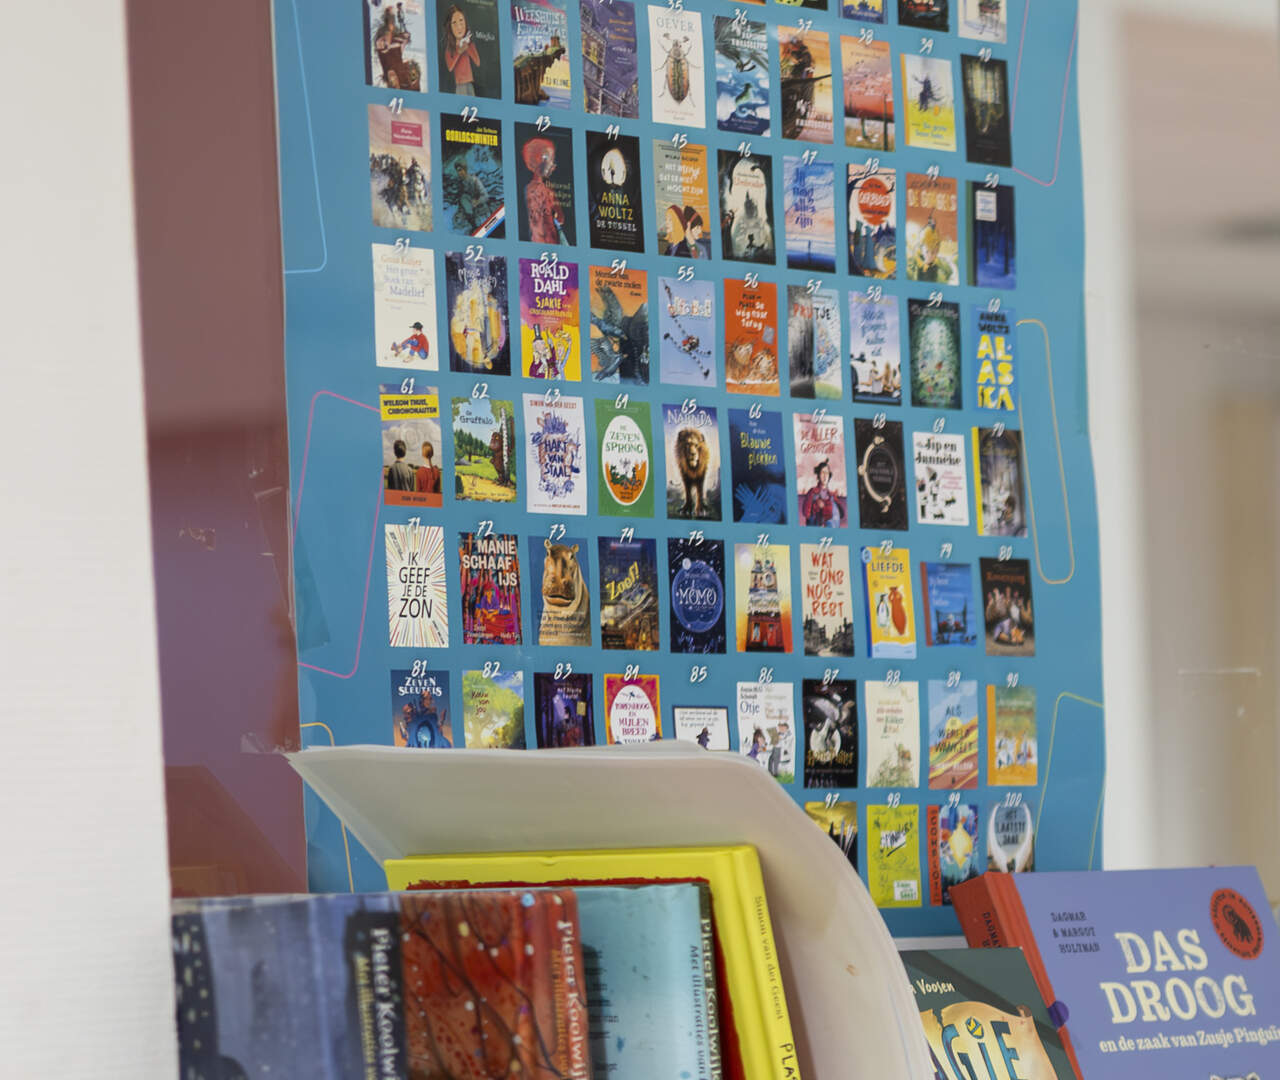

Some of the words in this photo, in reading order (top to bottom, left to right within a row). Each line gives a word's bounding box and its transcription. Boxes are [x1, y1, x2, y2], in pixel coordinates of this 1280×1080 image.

[600, 191, 631, 206] ANNA
[598, 205, 634, 221] WOLTZ
[393, 238, 410, 252] 51
[466, 245, 485, 262] 52
[540, 252, 559, 269] 53
[530, 261, 570, 281] ROALD
[677, 266, 695, 282] 55
[534, 279, 567, 296] DAHL
[743, 273, 759, 289] 56
[400, 377, 415, 394] 61
[471, 383, 490, 399] 62
[544, 388, 561, 404] 63
[681, 398, 697, 415] 65
[459, 415, 494, 426] Gruffalo
[605, 441, 645, 455] SPRONG
[408, 517, 421, 533] 71
[477, 520, 494, 537] 72
[549, 523, 566, 540] 73
[477, 539, 517, 555] MANIE
[408, 551, 419, 567] IK
[462, 554, 513, 571] SCHAAF
[811, 551, 834, 568] WAT
[870, 561, 905, 574] LIEFDE
[398, 567, 431, 585] GEEF
[498, 571, 518, 587] IJS
[402, 585, 414, 598] JE
[415, 585, 428, 598] DE
[398, 598, 433, 620] ZON
[411, 660, 428, 677] 81
[482, 661, 500, 678] 82
[553, 663, 572, 680] 83
[690, 666, 708, 683] 85
[404, 676, 437, 688] ZEVEN
[398, 686, 443, 697] SLEUTELS
[739, 701, 761, 714] Otje
[556, 920, 577, 986] Pieter
[700, 918, 714, 984] Pieter
[1114, 928, 1210, 974] DAS
[370, 928, 392, 997] Pieter
[916, 979, 956, 995] Voosen
[1100, 974, 1257, 1025] DROOG
[1099, 1039, 1117, 1053] en
[1118, 1036, 1135, 1053] de
[1136, 1034, 1173, 1050] zaak
[1173, 1036, 1198, 1048] van
[1198, 1029, 1234, 1048] Zusje
